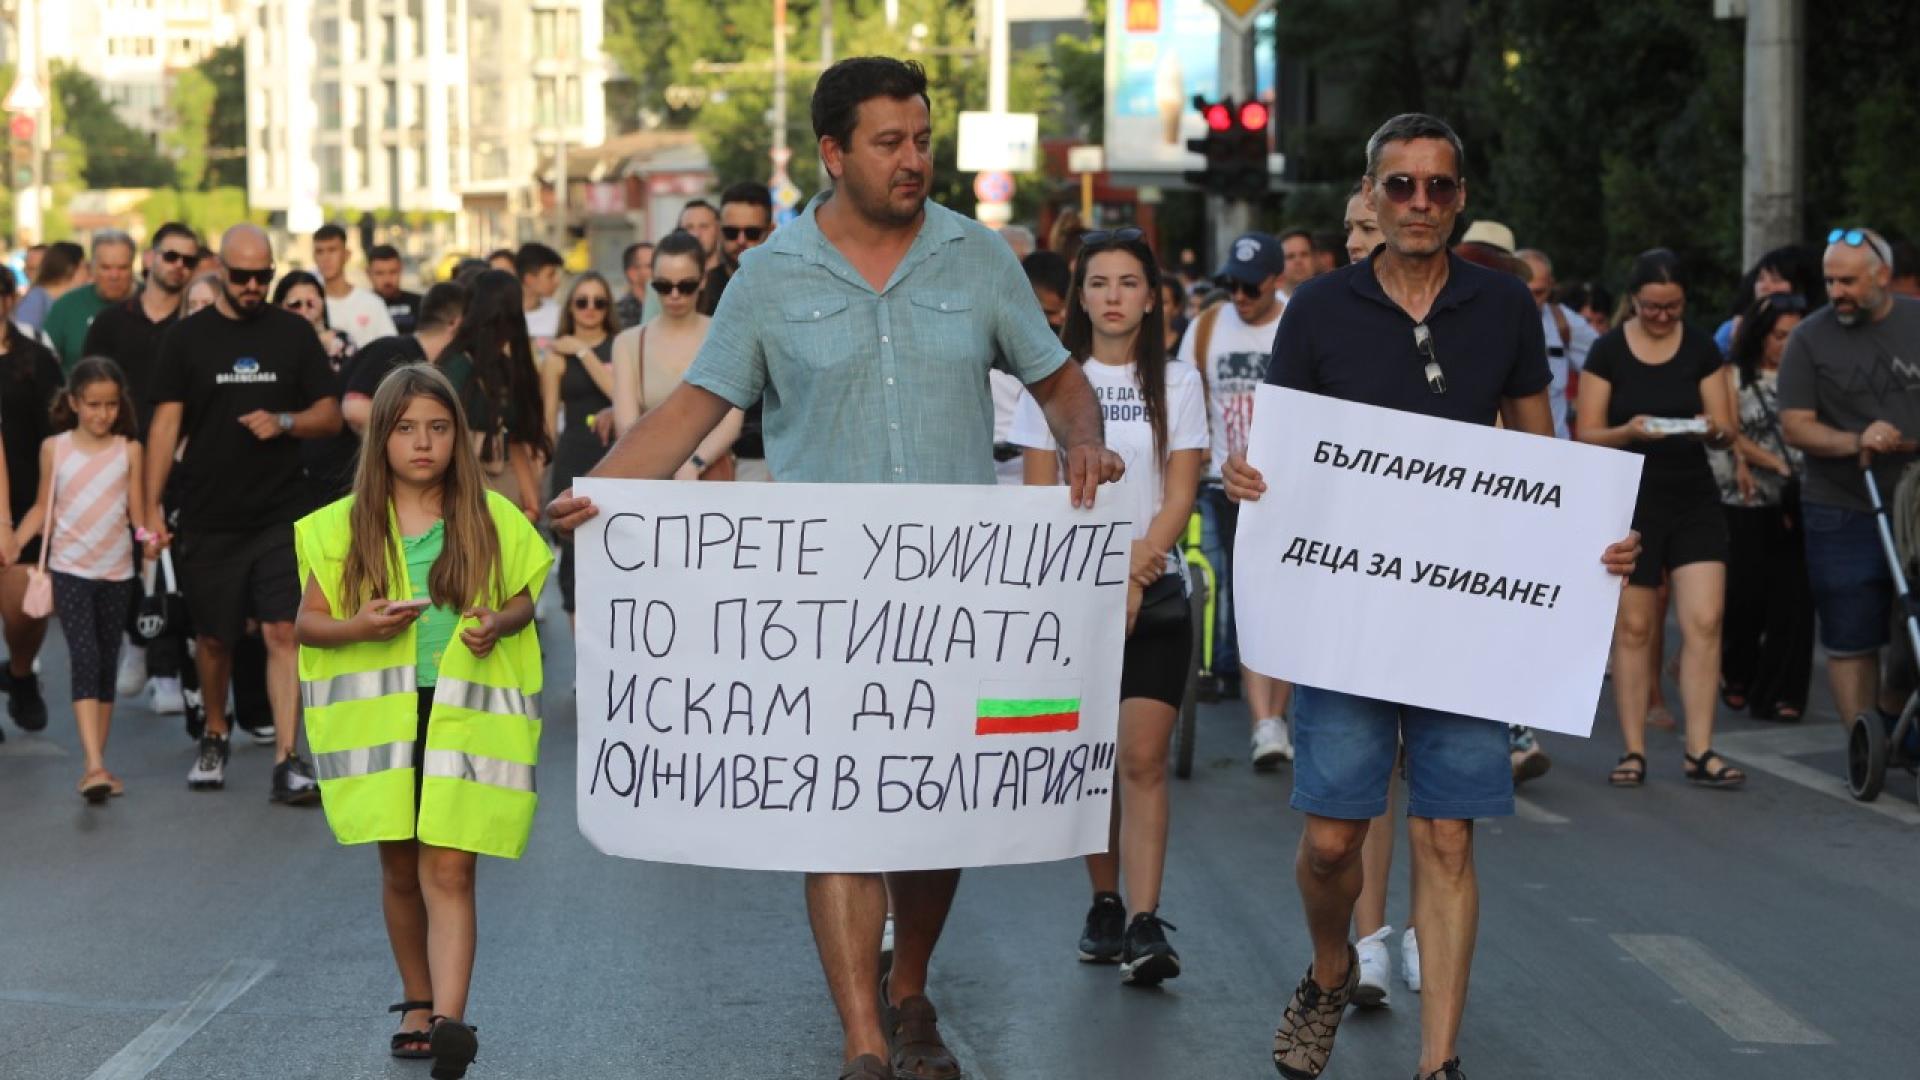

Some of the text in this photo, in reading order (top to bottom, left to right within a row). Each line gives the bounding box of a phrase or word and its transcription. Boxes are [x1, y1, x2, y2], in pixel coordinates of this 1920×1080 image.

[1118, 386, 1135, 401] ДА
[1313, 440, 1562, 508] БЪЛГАРИЯ НЯМА
[603, 512, 1132, 588] СПРЕТЕ УБИЙЦИТЕ
[1280, 536, 1562, 609] ДЕЦА ЗА УБИВАНЕ!
[610, 598, 1072, 667] ПО ПЪТИЩАТА,
[606, 669, 936, 736] ИСКАМ ДА
[831, 754, 861, 811] В
[877, 741, 1116, 814] БЪЛГАРИЯ!!!
